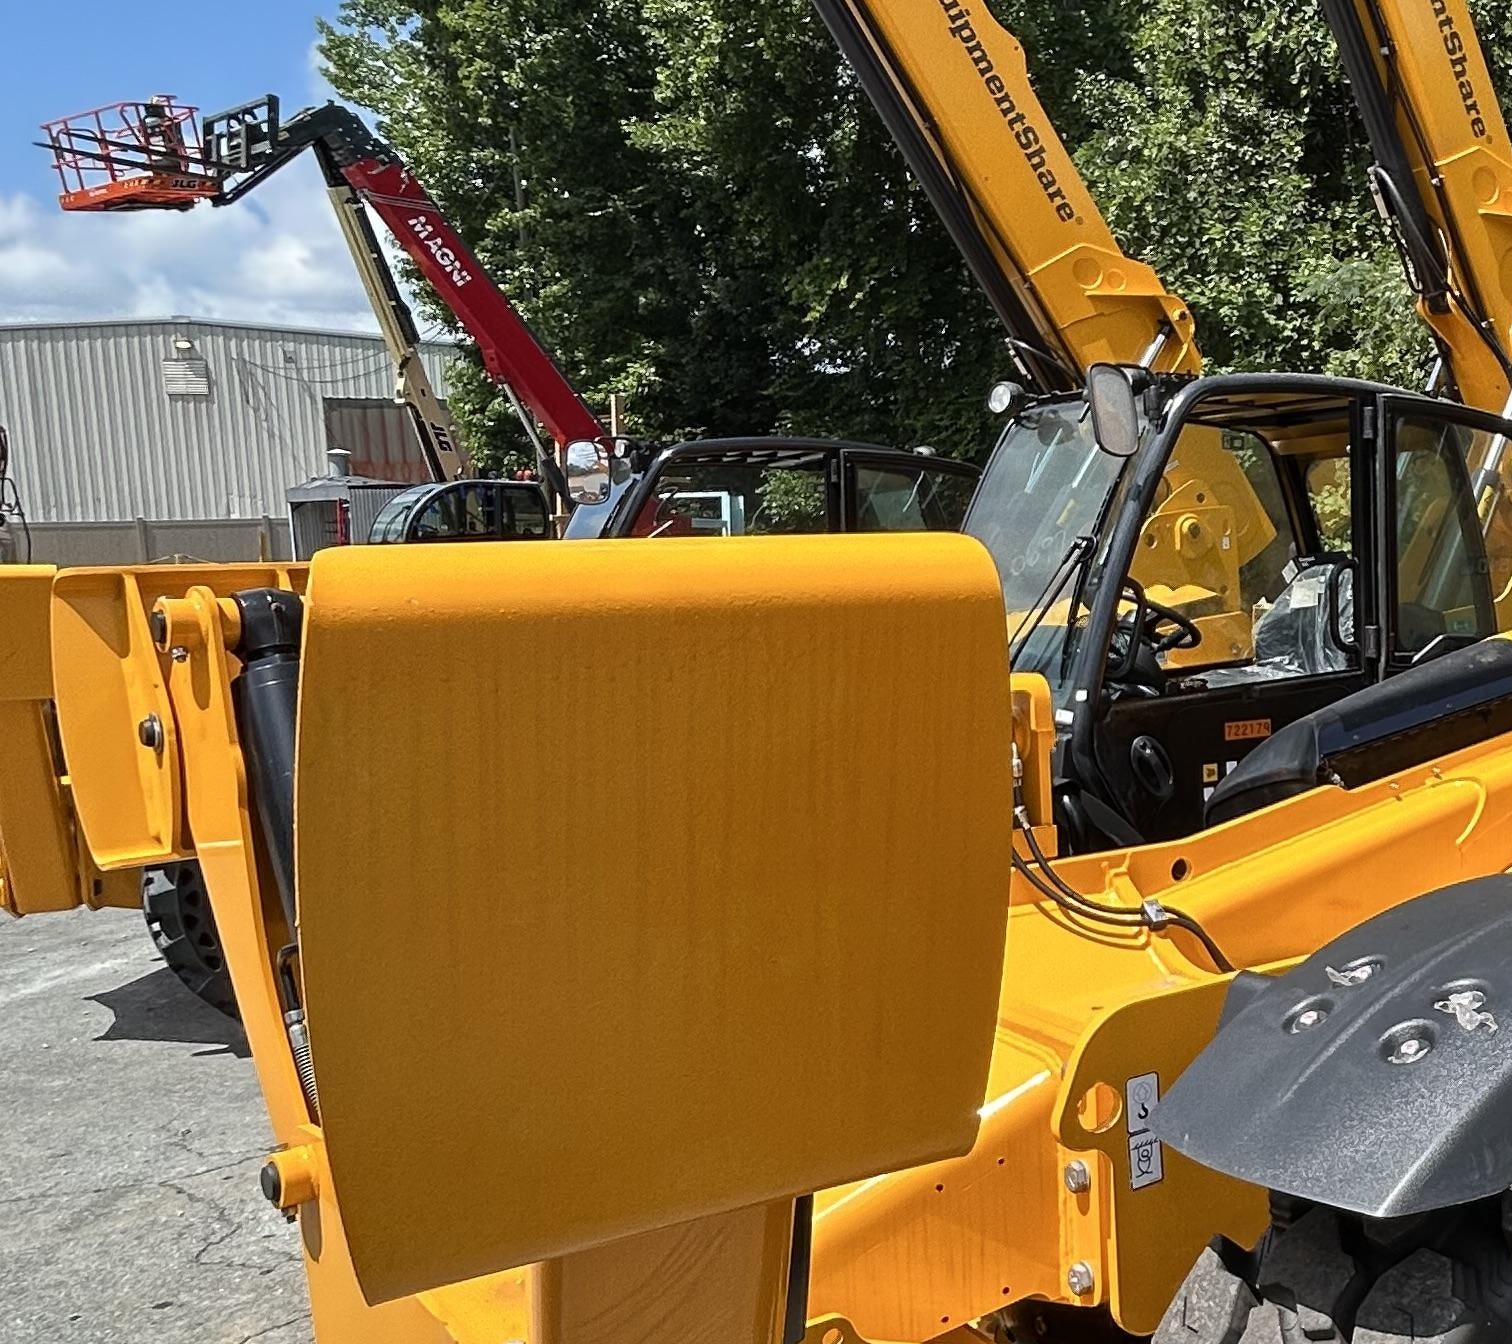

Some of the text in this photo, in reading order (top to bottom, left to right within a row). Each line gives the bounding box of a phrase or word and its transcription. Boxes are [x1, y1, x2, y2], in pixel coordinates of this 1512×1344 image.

[171, 178, 198, 189] JLG
[407, 215, 473, 288] MAGNI
[430, 421, 453, 452] JLG
